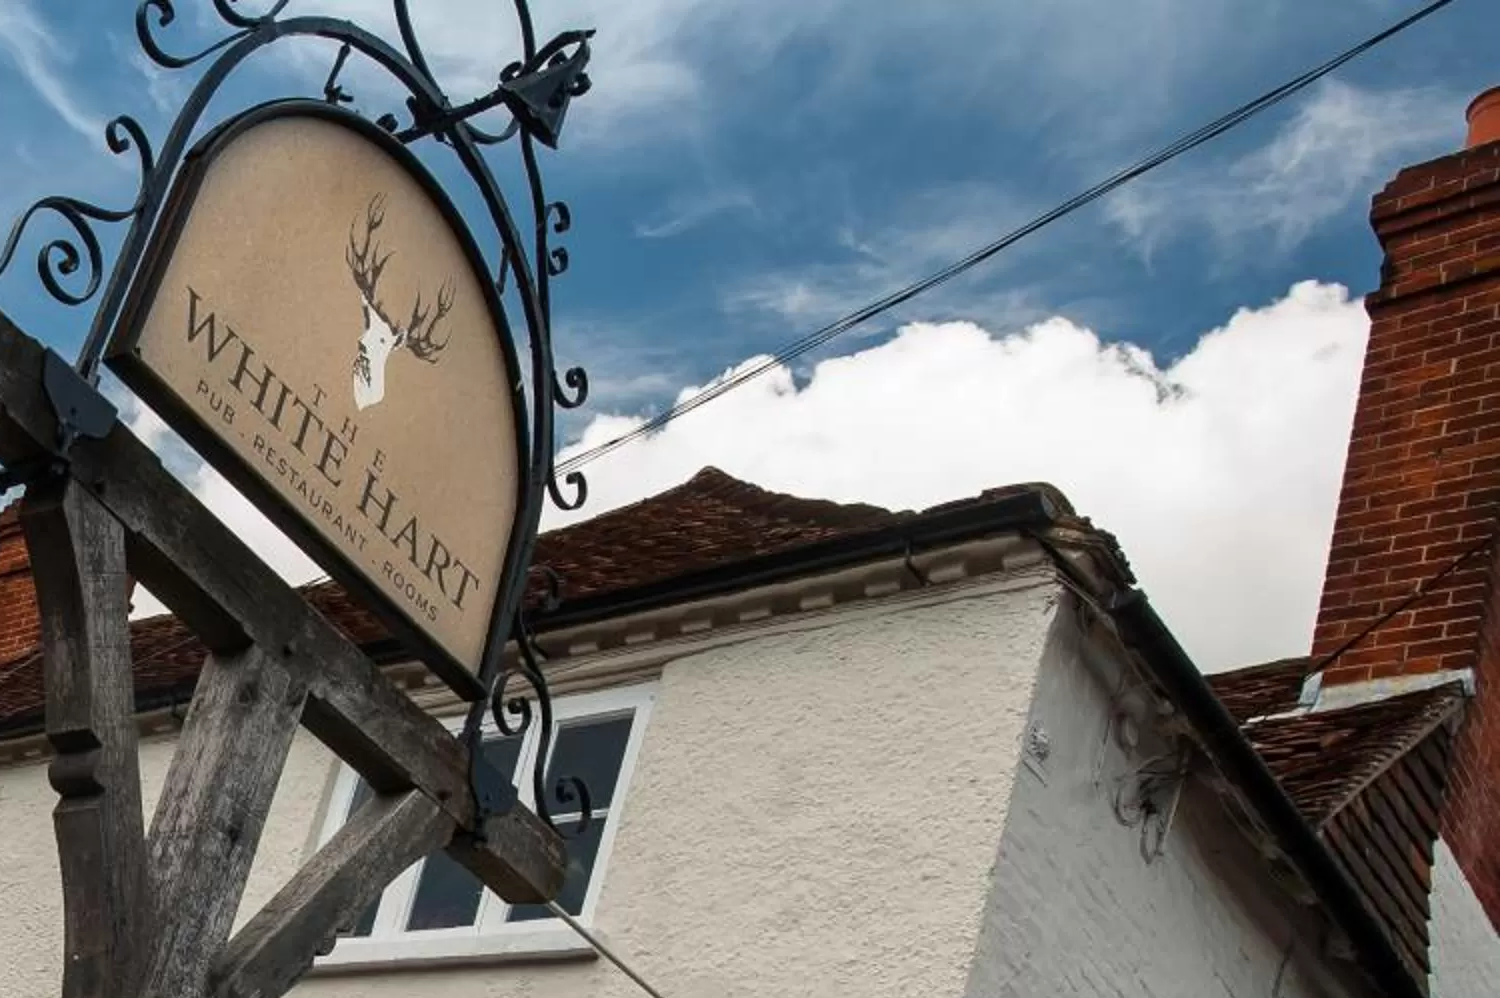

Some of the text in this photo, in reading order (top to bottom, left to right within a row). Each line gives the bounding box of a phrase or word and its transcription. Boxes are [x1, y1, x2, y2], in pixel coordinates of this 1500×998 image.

[185, 285, 480, 611] WHITE HART
[195, 379, 438, 622] PUB RESTAURANT ROOMS
[312, 384, 387, 473] THE
